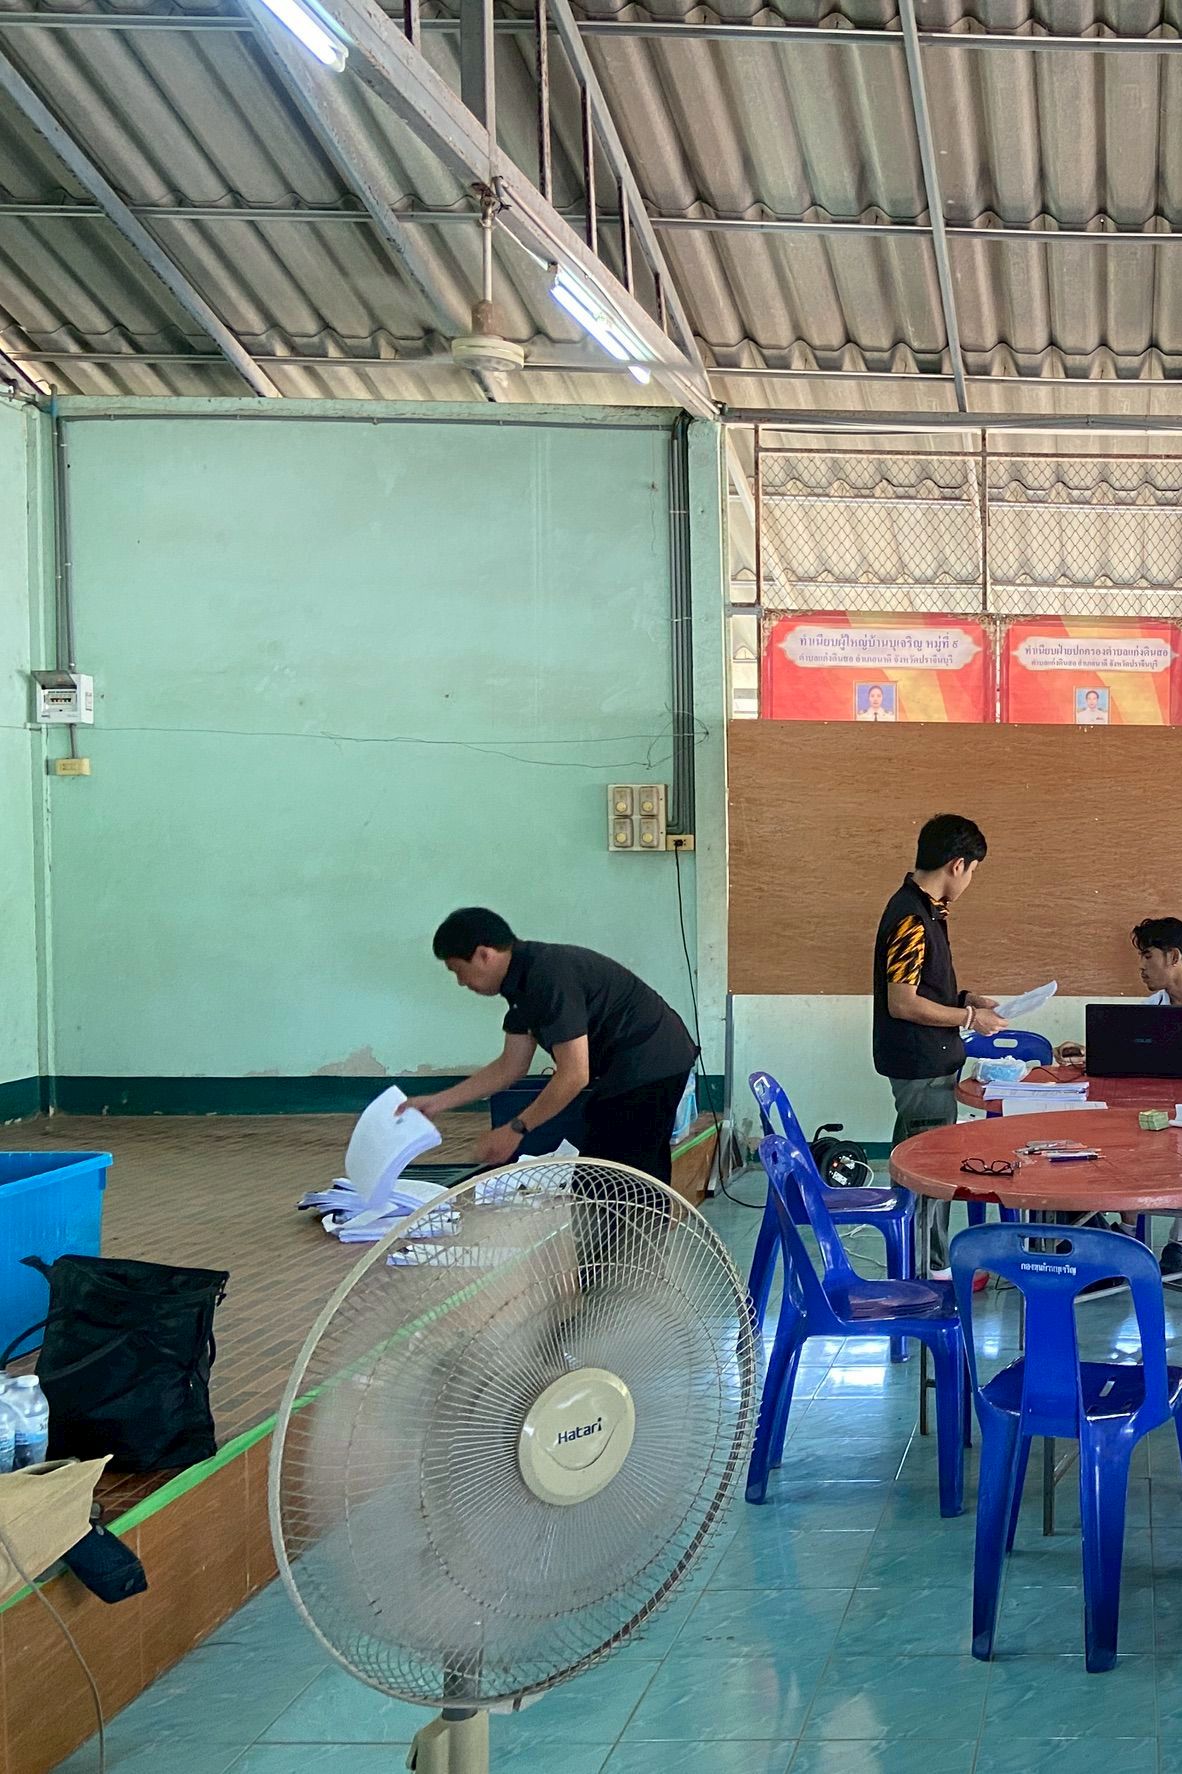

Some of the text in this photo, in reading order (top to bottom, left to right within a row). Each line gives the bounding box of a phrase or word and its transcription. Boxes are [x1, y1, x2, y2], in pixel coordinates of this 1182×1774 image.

[799, 634, 922, 652] ทำเนียบผู้ใหญ่บ้านบุเจริญ
[926, 632, 950, 653] หมู่ที่
[1024, 643, 1169, 658] ทำเนียบฝ่ายปกครองตำบลแก่งดินสอ
[557, 1416, 603, 1445] Hatari
